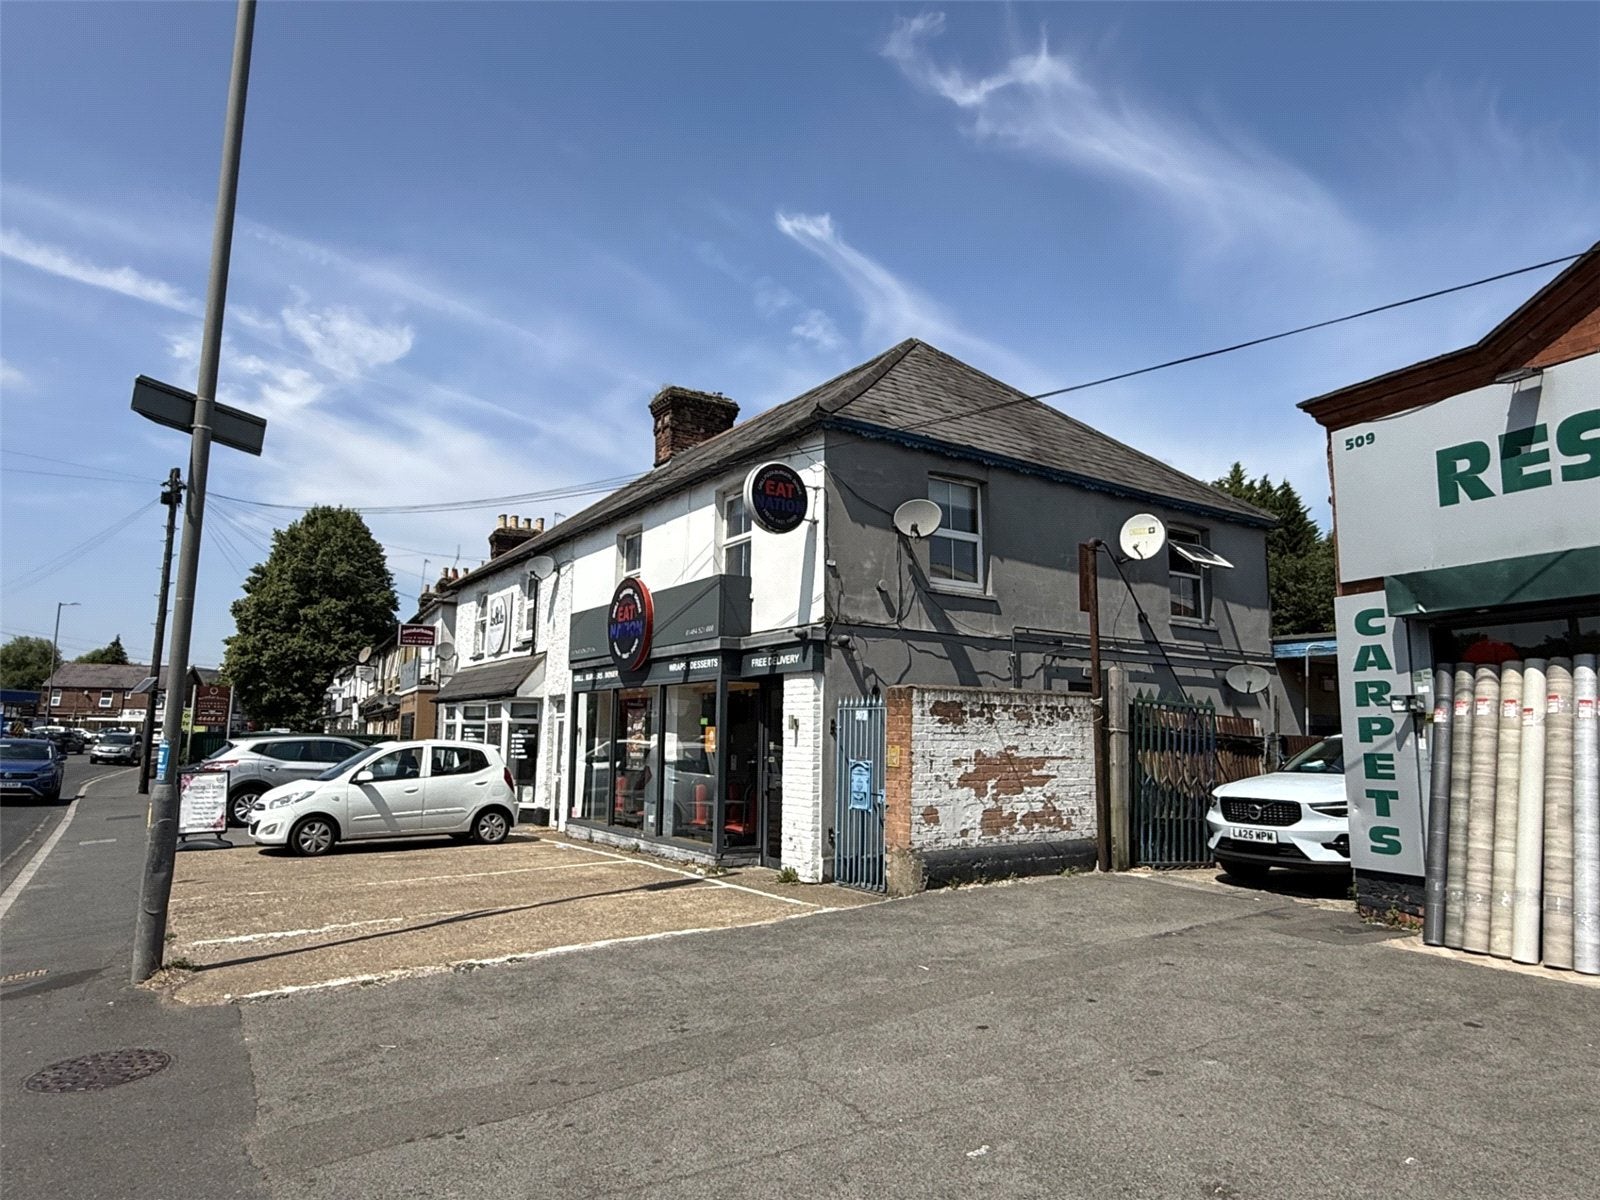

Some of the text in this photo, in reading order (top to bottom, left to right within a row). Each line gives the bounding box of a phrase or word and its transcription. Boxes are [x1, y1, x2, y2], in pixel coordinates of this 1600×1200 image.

[1344, 432, 1375, 451] 509
[1436, 408, 1600, 507] RES
[765, 479, 795, 498] EAT
[756, 496, 805, 513] NATION
[617, 604, 636, 622] EAT
[690, 658, 719, 670] DESSERTS
[751, 653, 800, 668] FREE DELIVERY
[1353, 607, 1402, 856] CARPETS
[1232, 828, 1254, 839] LA25
